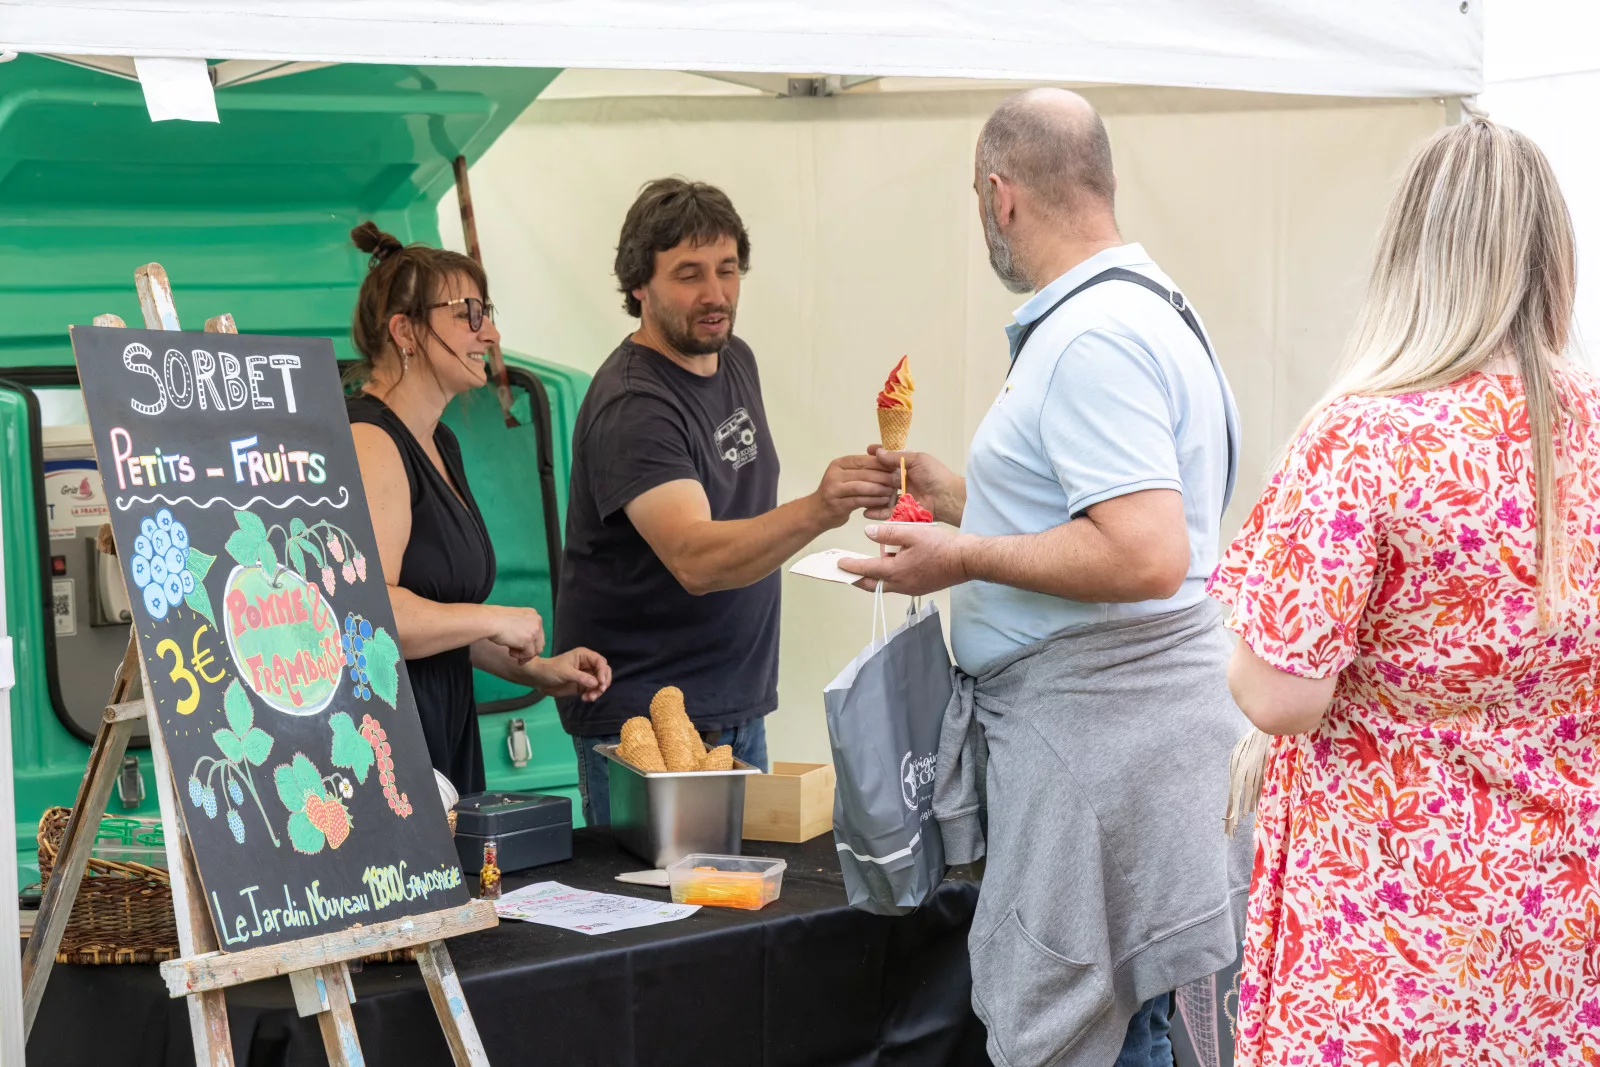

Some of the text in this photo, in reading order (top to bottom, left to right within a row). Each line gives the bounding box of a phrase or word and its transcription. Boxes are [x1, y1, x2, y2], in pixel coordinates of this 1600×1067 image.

[123, 342, 301, 415] SORBET
[81, 507, 107, 515] FRANÇA
[225, 587, 309, 638] POMME
[156, 624, 226, 715] 3€
[212, 891, 249, 945] Le
[239, 884, 310, 936] Jardin
[305, 880, 370, 926] Nouveau
